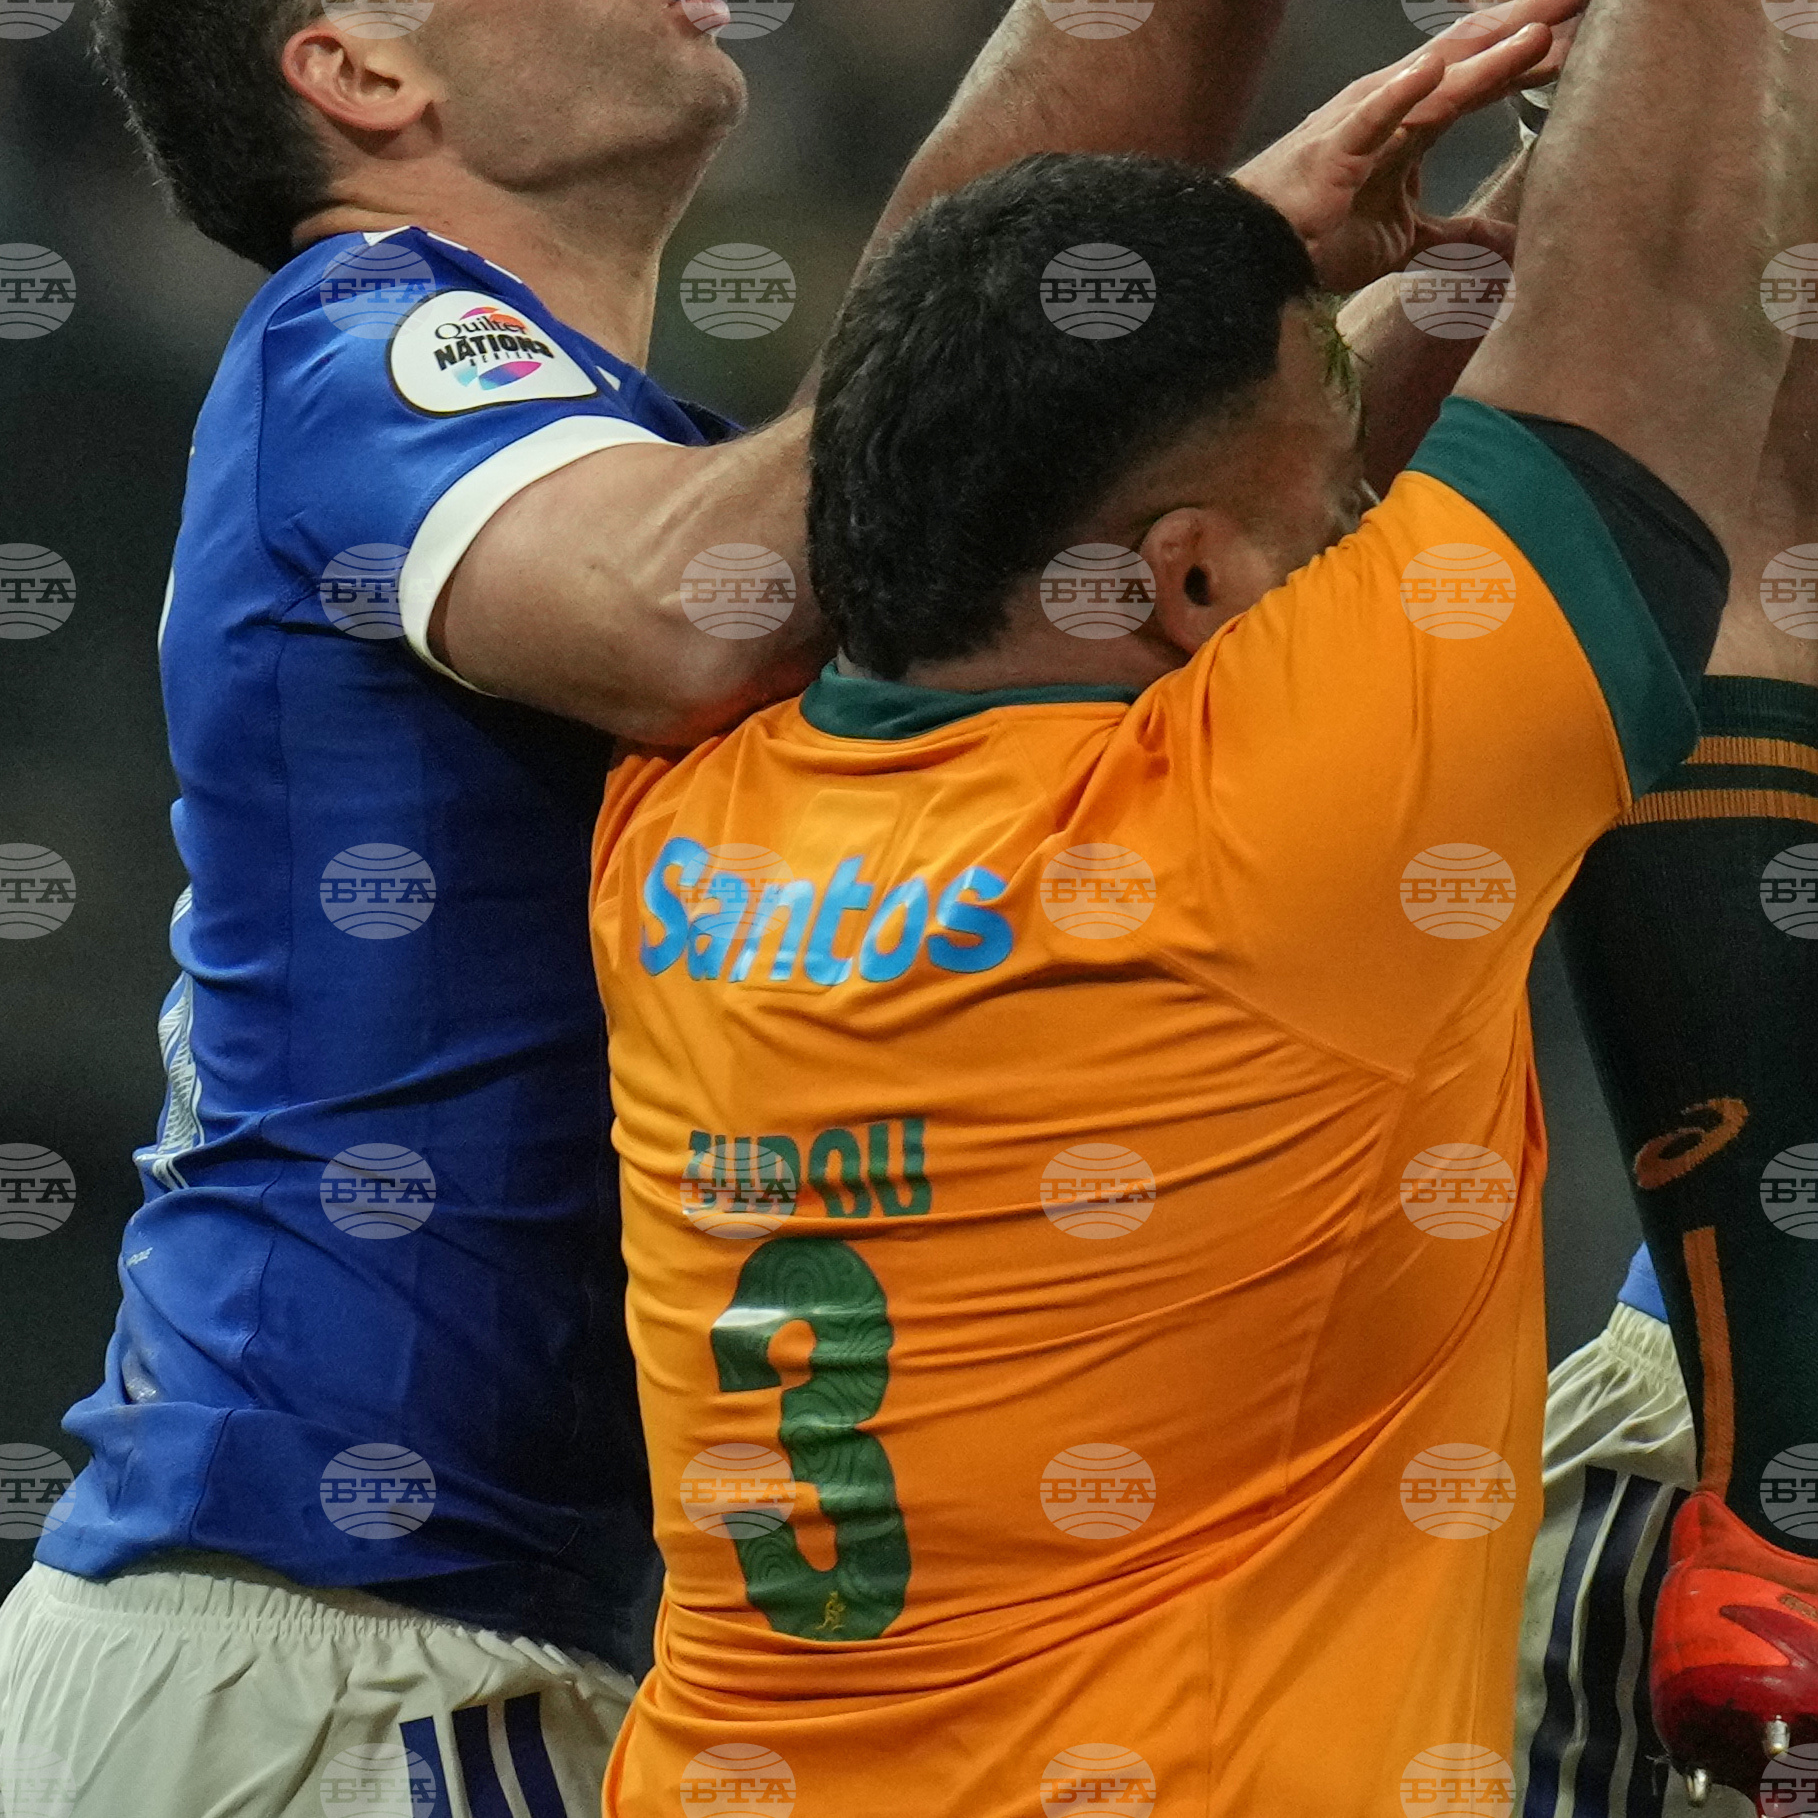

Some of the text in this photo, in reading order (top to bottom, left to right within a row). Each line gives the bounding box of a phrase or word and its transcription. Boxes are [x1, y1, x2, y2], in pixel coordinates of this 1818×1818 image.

[434, 315, 528, 340] Quilter
[637, 833, 1016, 987] Santos
[709, 1237, 912, 1642] 3
